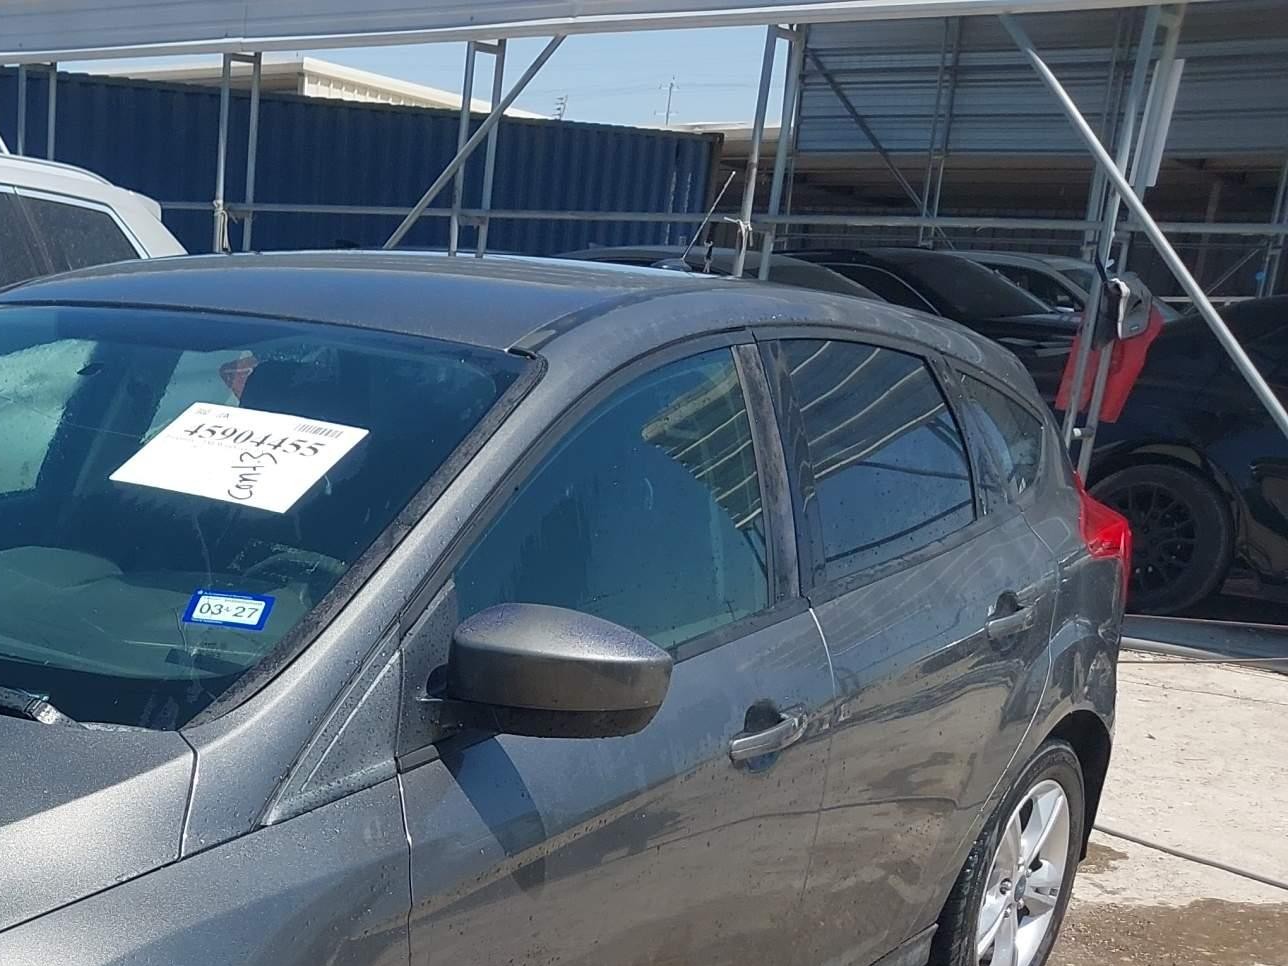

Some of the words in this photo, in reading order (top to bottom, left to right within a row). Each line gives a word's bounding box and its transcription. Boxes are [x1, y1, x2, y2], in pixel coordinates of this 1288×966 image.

[184, 423, 326, 457] 45904455
[199, 603, 223, 616] 03
[232, 606, 258, 618] 27
